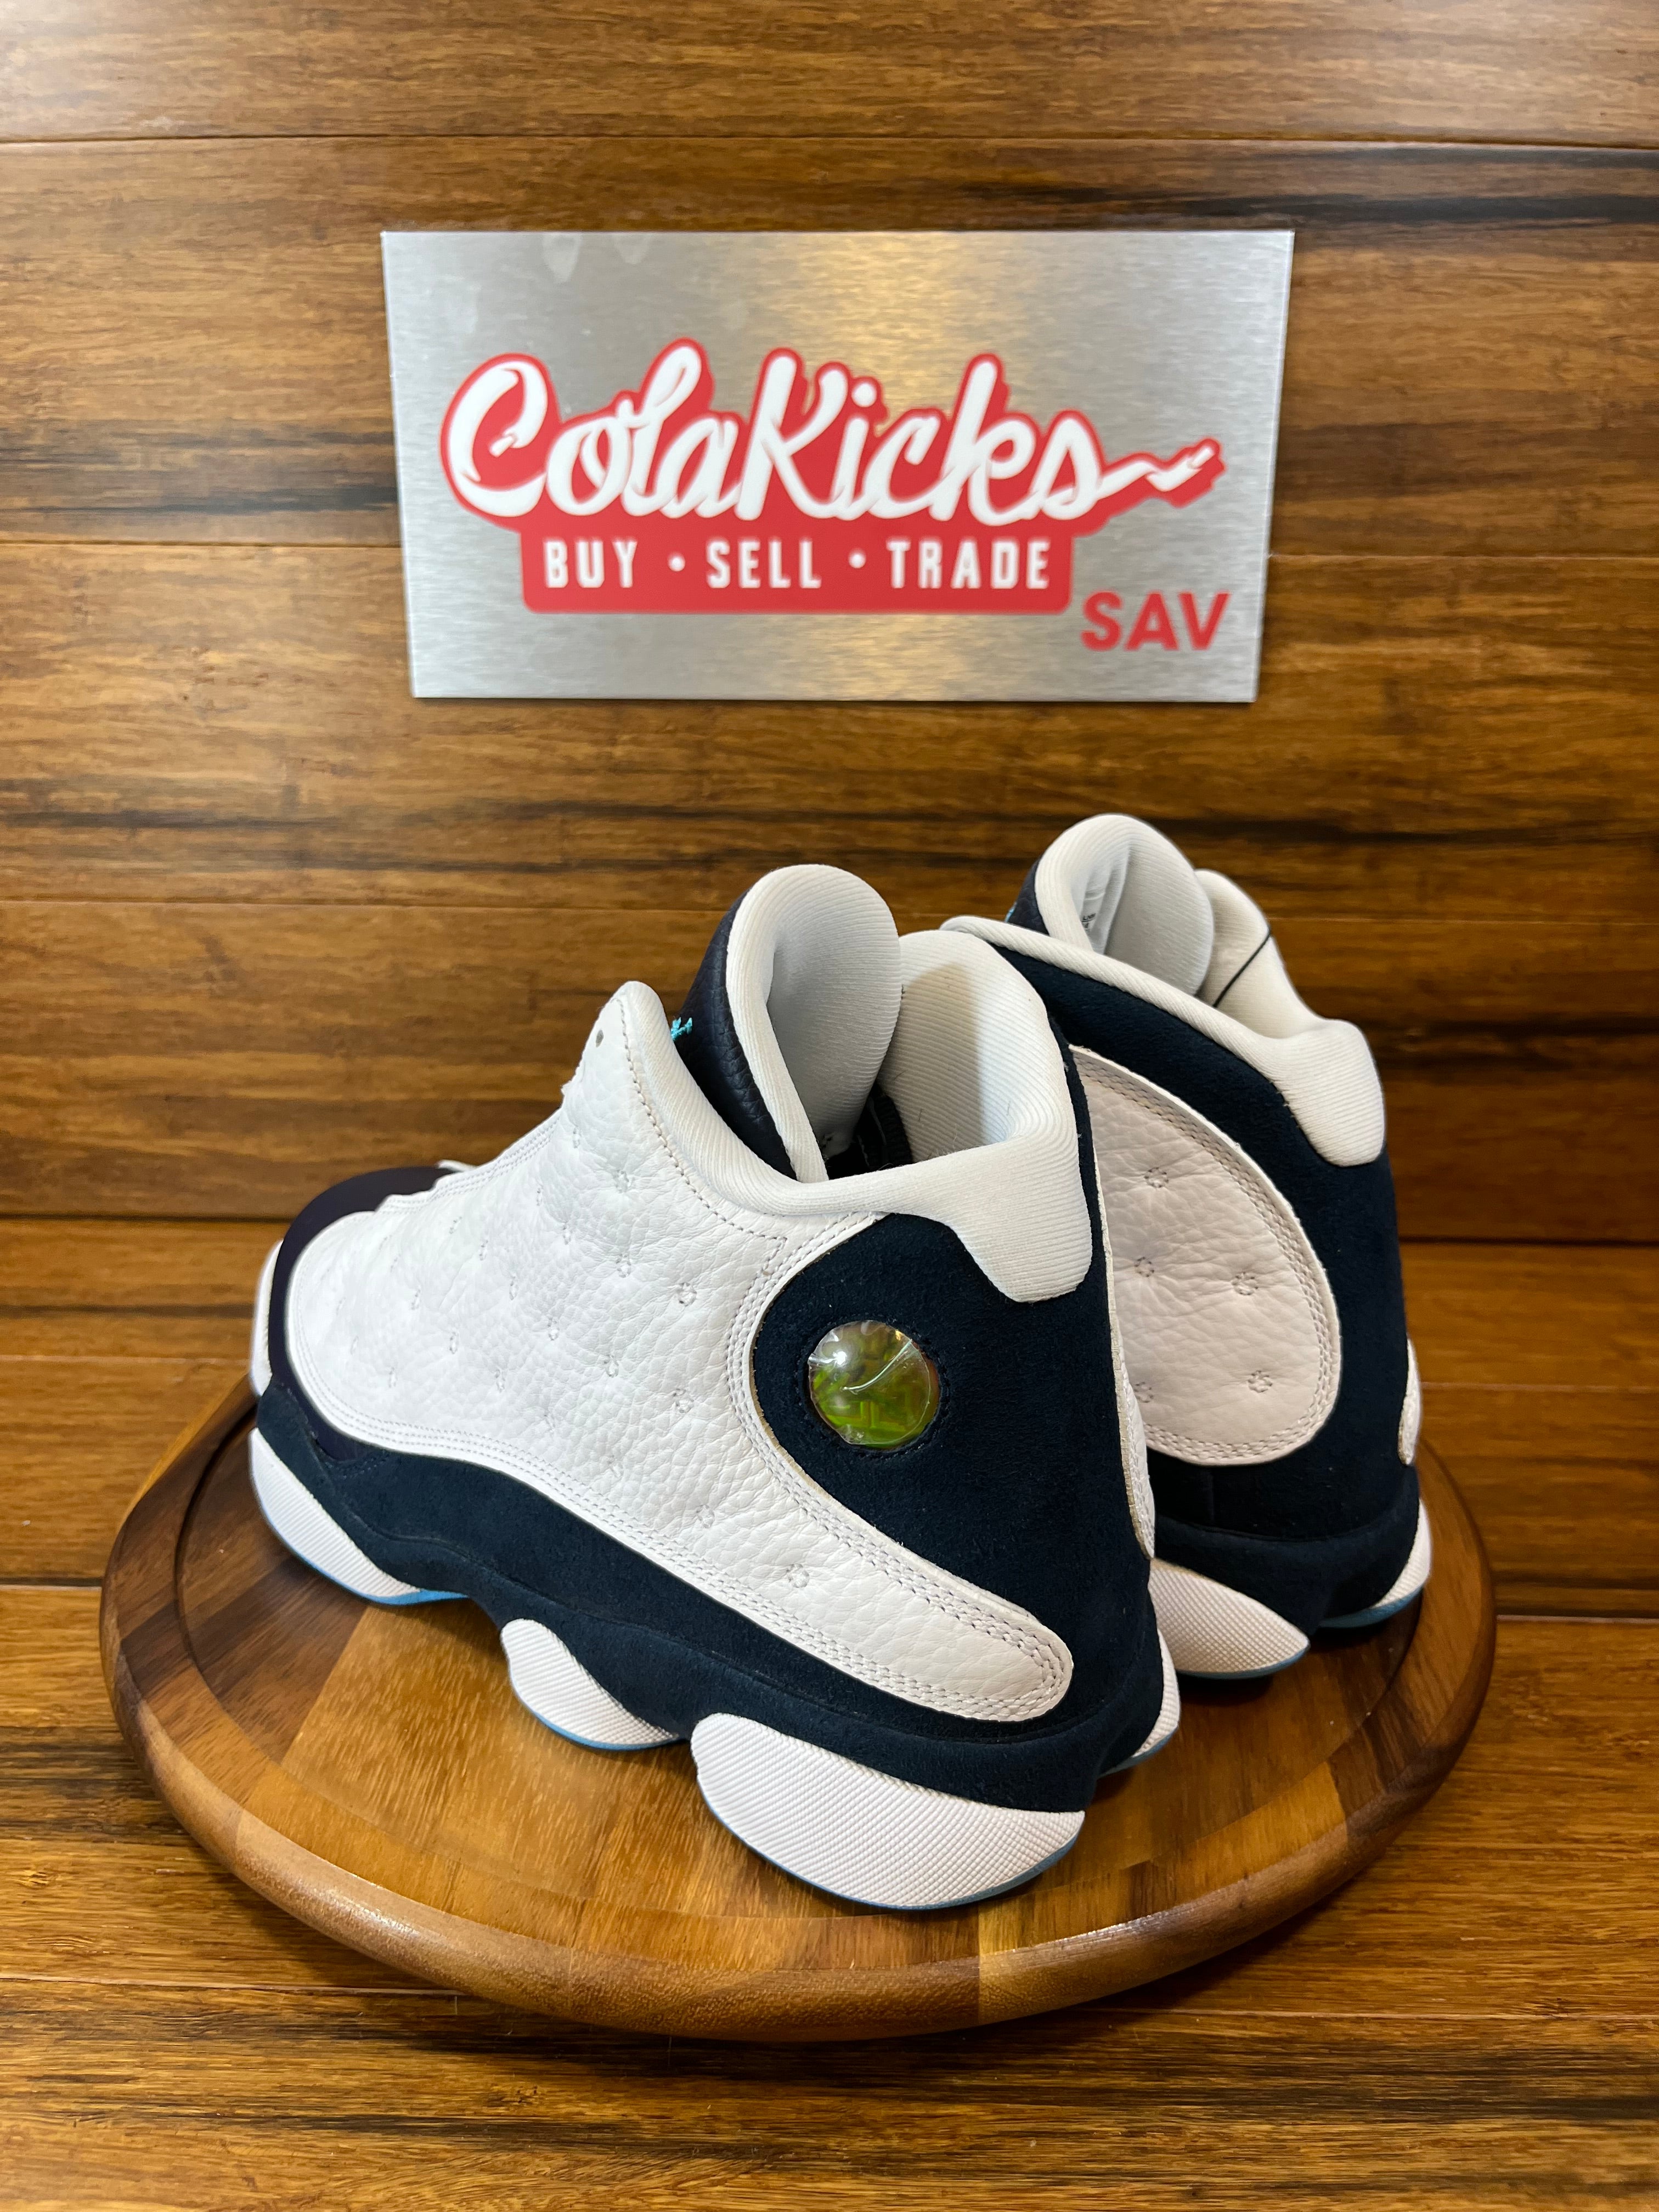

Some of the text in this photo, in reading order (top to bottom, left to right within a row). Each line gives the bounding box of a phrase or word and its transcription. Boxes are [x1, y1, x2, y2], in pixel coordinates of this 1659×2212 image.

[448, 346, 1215, 526] ColaKicks
[543, 538, 1050, 589] BUY SELL TRADE
[1081, 591, 1229, 650] SAV
